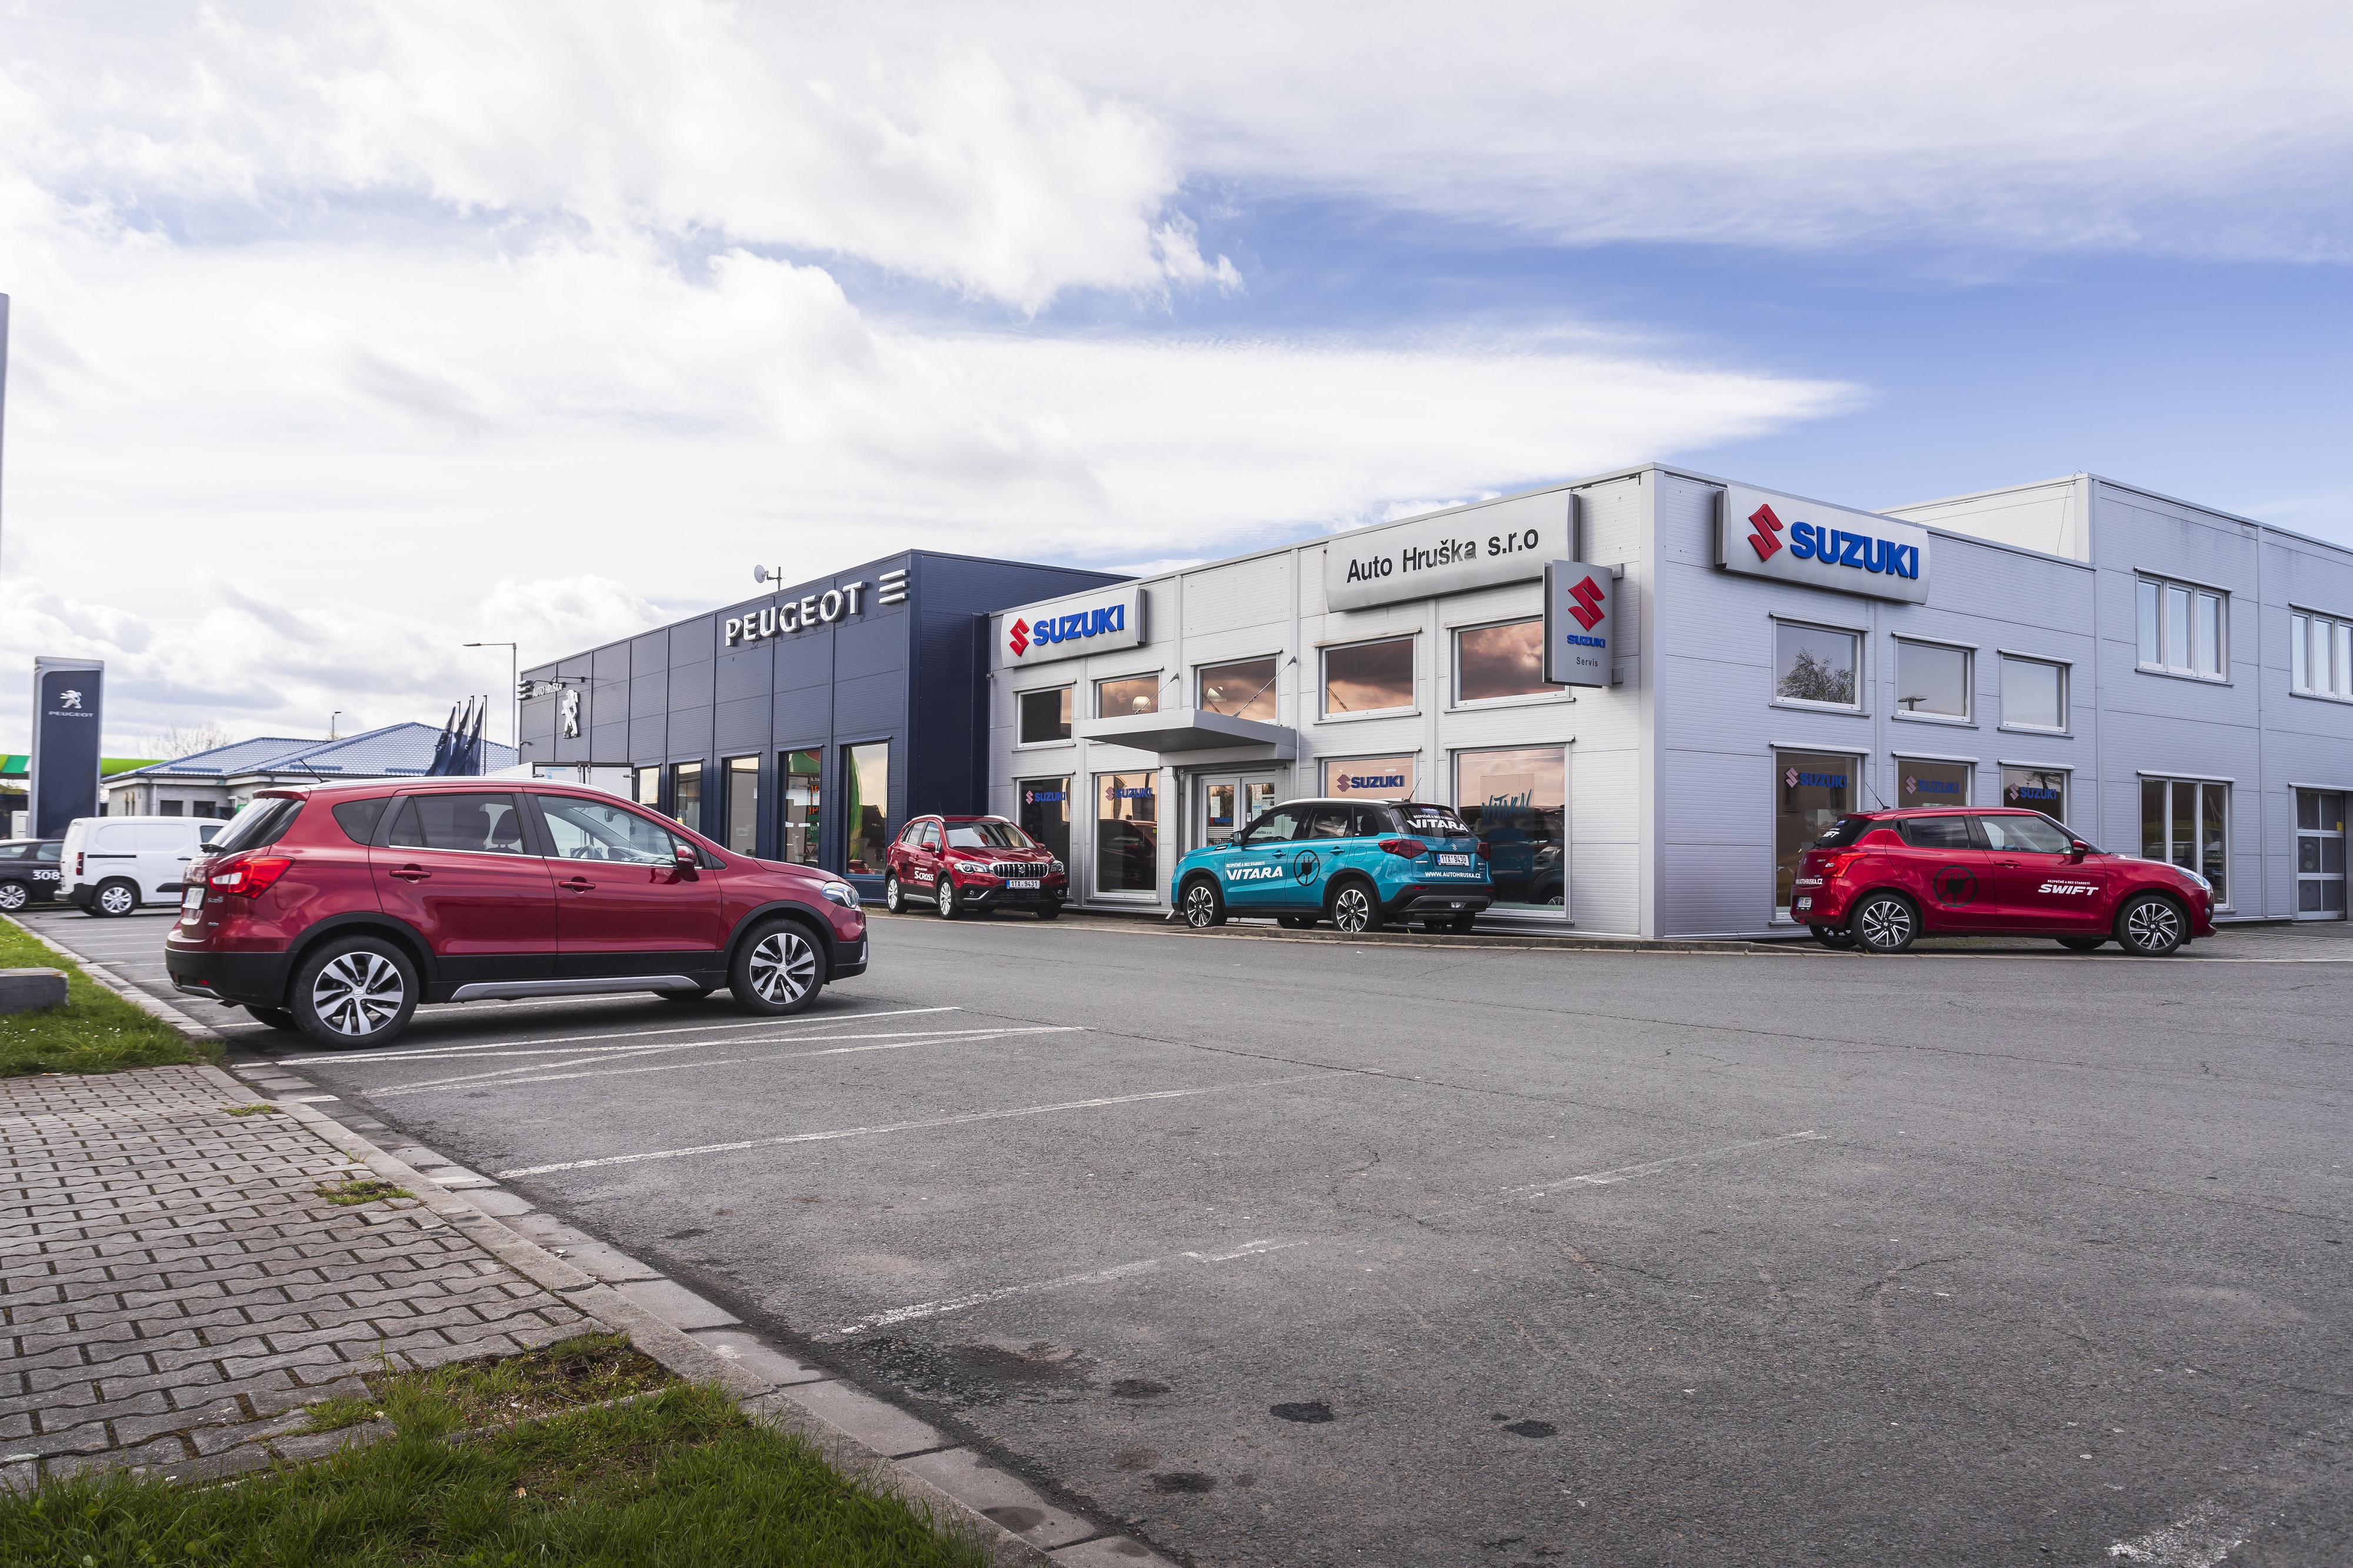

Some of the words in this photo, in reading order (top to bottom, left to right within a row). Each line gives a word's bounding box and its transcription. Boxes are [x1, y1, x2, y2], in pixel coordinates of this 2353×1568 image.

[1347, 556, 1392, 583] Auto
[1402, 539, 1477, 573] Hruška
[1488, 529, 1539, 556] s.r.o
[1791, 521, 1919, 580] SUZUKI
[725, 581, 866, 646] PEUGEOT
[1033, 603, 1125, 646] SUZUKI
[1567, 634, 1606, 648] SUZUKI
[1577, 656, 1598, 667] Servis
[532, 686, 545, 698] AUTO
[1351, 775, 1405, 789] SUZUKI
[1799, 772, 1847, 789] SUZUKI
[1918, 780, 1959, 794] SUZUKI
[1034, 791, 1066, 802] SUZUKI
[1115, 787, 1153, 799] SUZUKI
[2020, 786, 2057, 800] SUZUKI
[1407, 819, 1469, 832] VITARA
[1441, 855, 1451, 863] 1TX
[1454, 855, 1467, 863] 9430
[32, 872, 61, 880] 308
[914, 870, 934, 881] S-CROSS
[1226, 866, 1283, 880] VITARA
[2038, 884, 2099, 896] SWIFT
